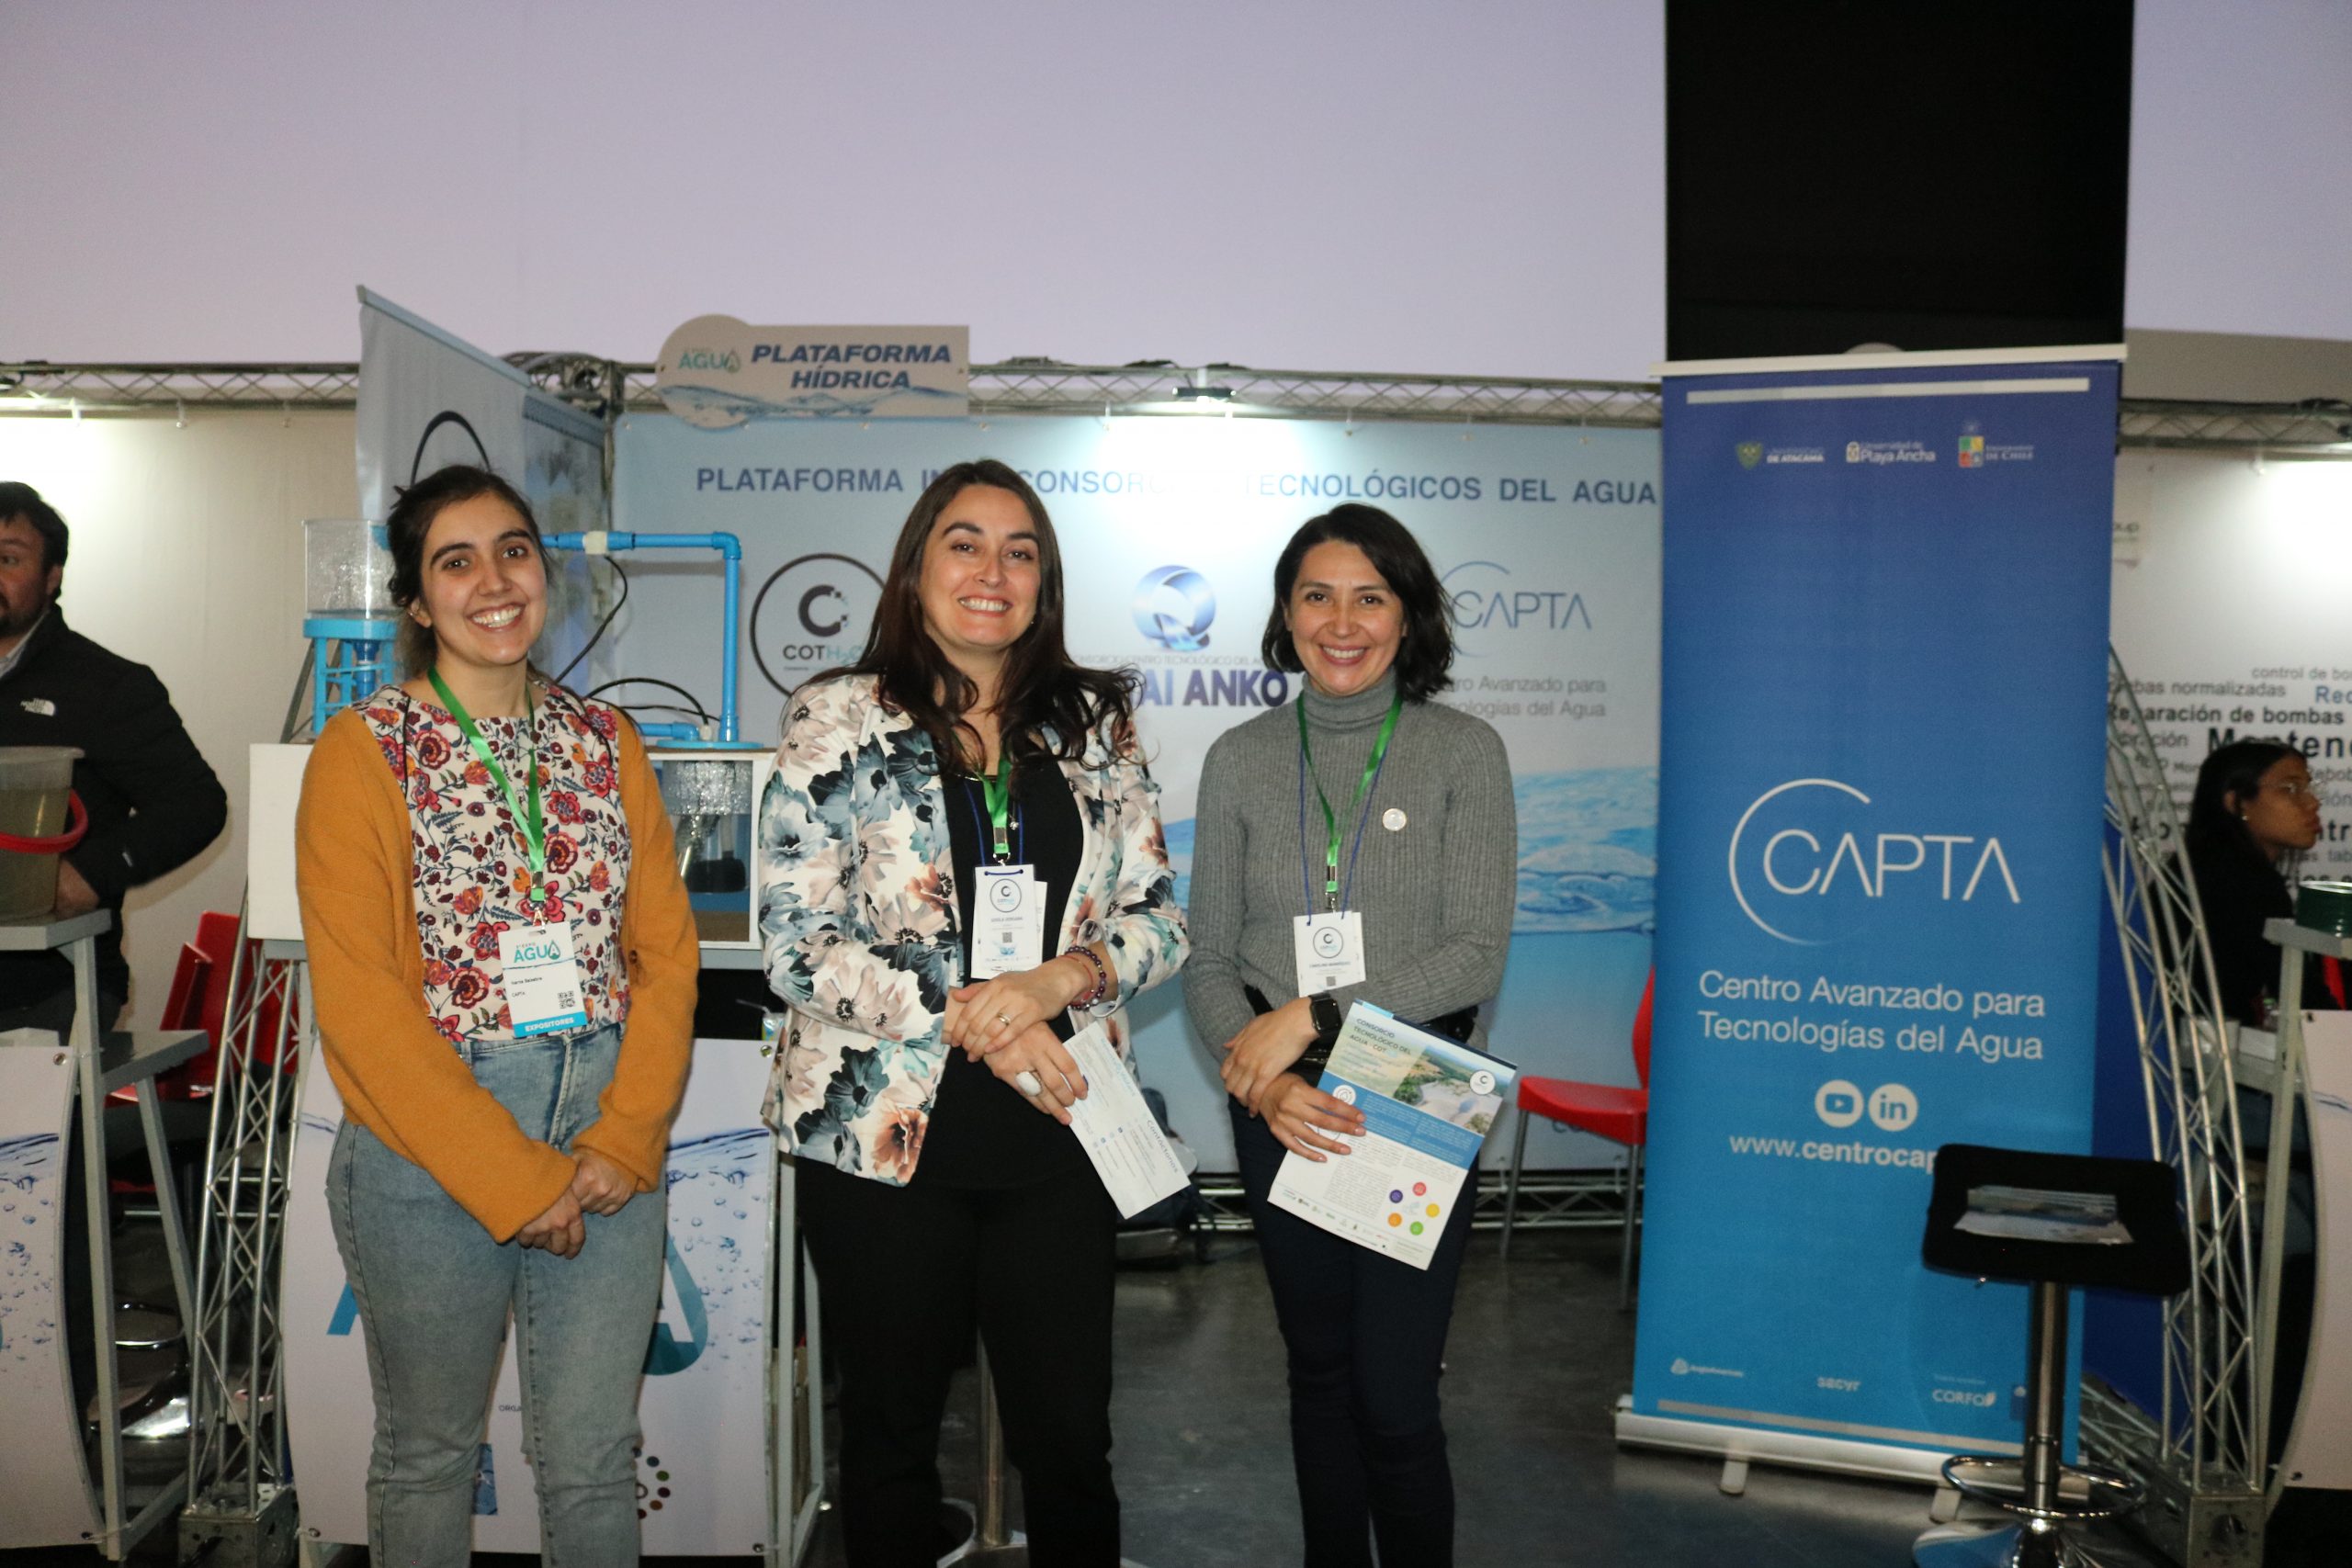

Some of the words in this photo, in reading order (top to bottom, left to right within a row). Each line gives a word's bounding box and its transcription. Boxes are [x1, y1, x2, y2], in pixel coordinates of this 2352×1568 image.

[751, 344, 952, 364] PLATAFORMA
[790, 365, 911, 389] HÍDRICA
[1860, 448, 1894, 466] Playa
[1895, 448, 1936, 463] Ancha
[696, 468, 904, 492] PLATAFORMA
[1499, 478, 1556, 502] DEL
[1573, 480, 1657, 504] AGUA
[1452, 590, 1592, 630] CAPTA
[1182, 668, 1288, 707] ANKO
[1478, 675, 1563, 694] Avanzado
[1567, 679, 1607, 696] para
[1527, 700, 1554, 716] del
[1560, 700, 1606, 720] Agua
[2230, 706, 2255, 724] de
[2263, 706, 2344, 725] bombas
[1763, 829, 2021, 904] CAPTA
[1699, 969, 1802, 1003] Centro
[1810, 976, 1963, 1012] Avanzado
[1973, 991, 2046, 1019] para
[1697, 1010, 1885, 1053] Tecnologías
[1896, 1024, 1945, 1053] del
[1956, 1026, 2044, 1064] Agua
[1729, 1134, 1938, 1175] www.centrocap
